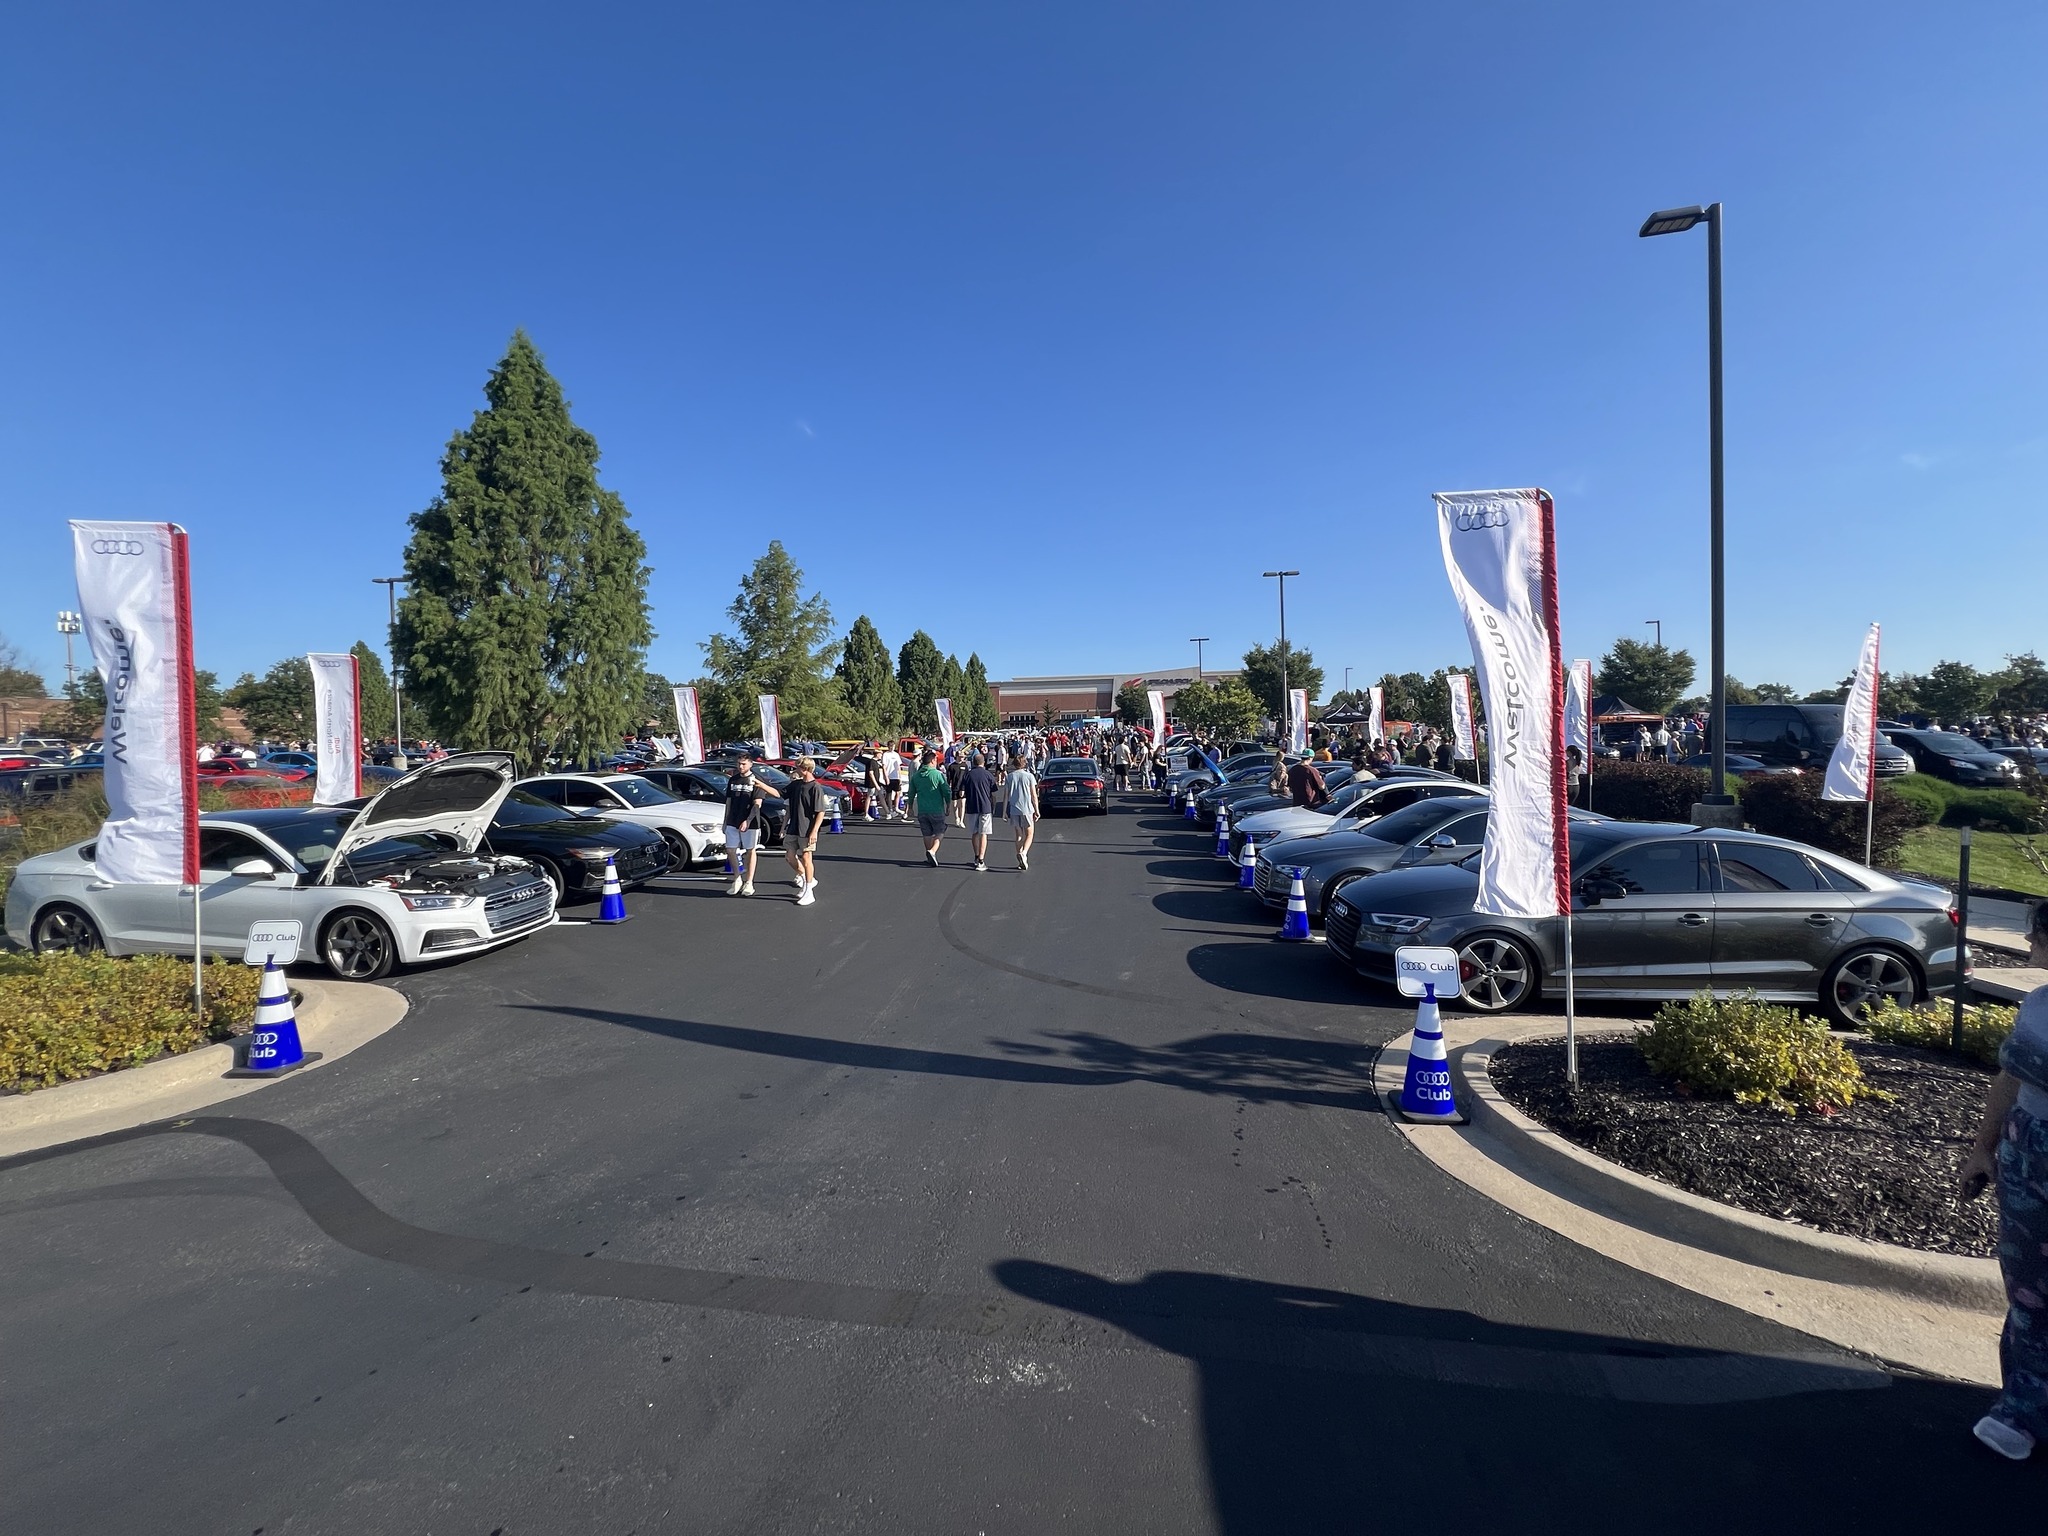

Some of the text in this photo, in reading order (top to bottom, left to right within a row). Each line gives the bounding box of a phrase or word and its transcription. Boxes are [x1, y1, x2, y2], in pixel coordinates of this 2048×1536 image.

[276, 934, 296, 942] Club
[1430, 963, 1454, 972] Club
[1416, 1087, 1452, 1102] Club
